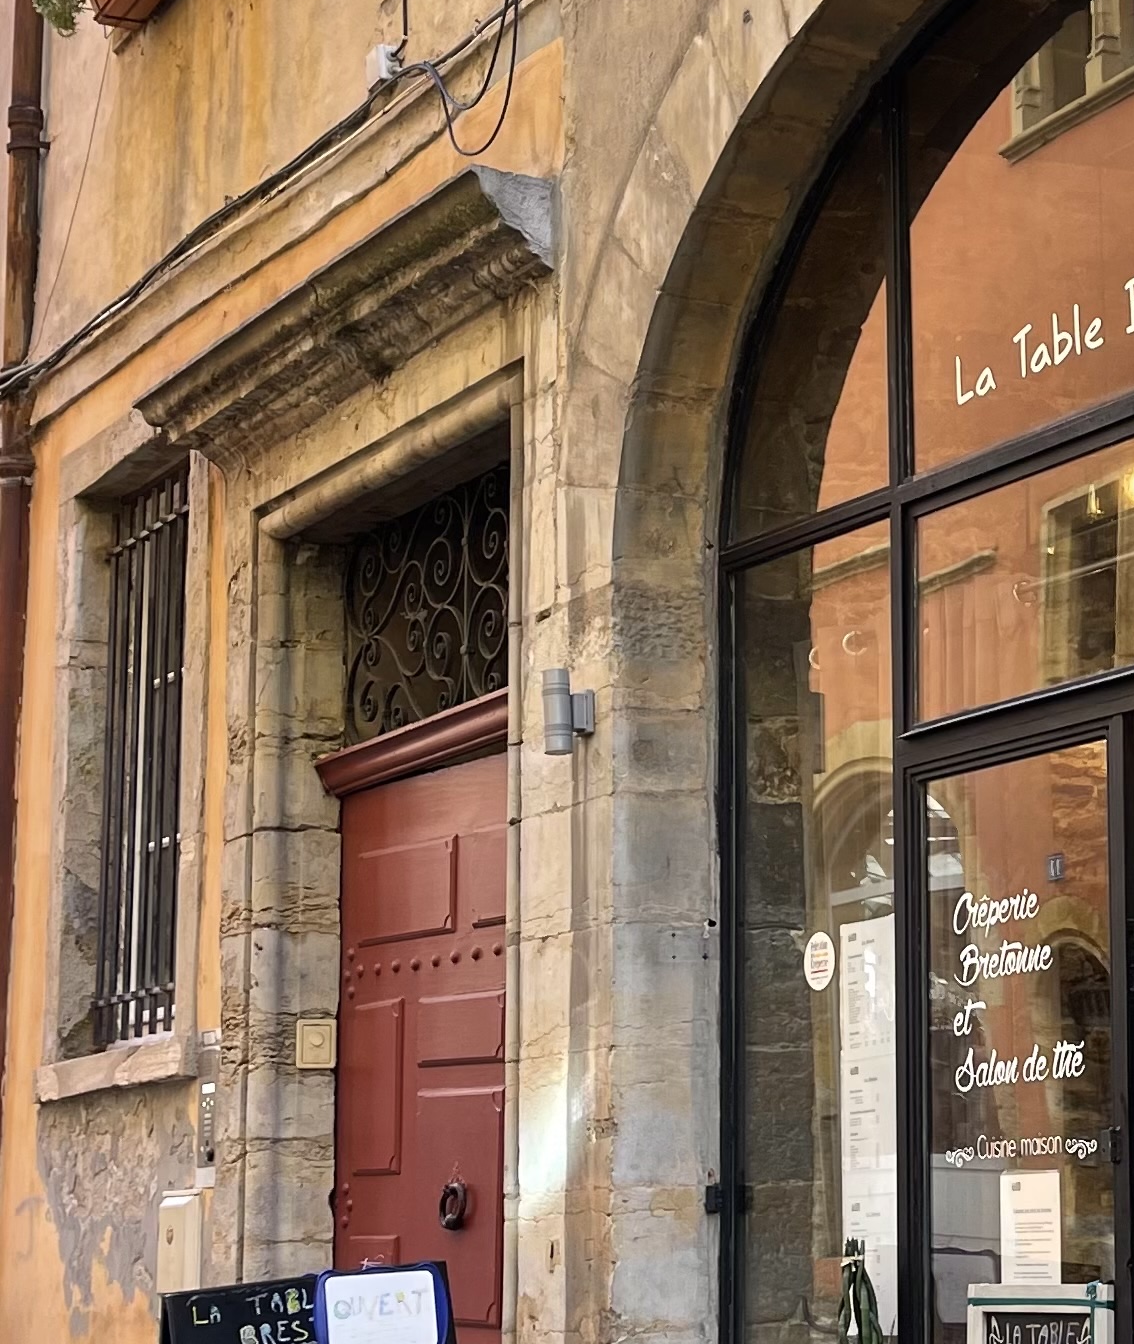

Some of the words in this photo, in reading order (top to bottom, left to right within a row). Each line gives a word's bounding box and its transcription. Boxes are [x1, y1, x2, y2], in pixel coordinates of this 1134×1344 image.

[955, 355, 998, 406] La
[1012, 303, 1104, 378] Table
[953, 888, 1040, 939] Crêperie
[953, 939, 1054, 987] Bretonne
[953, 998, 987, 1037] et
[955, 1047, 1020, 1093] Salon
[1022, 1043, 1050, 1083] de
[1049, 1040, 1086, 1079] thé
[976, 1134, 1017, 1159] Cuisine
[1020, 1132, 1063, 1156] maison
[192, 1305, 221, 1326] LA
[246, 1287, 315, 1315] TABL
[333, 1288, 429, 1320] OUVERT
